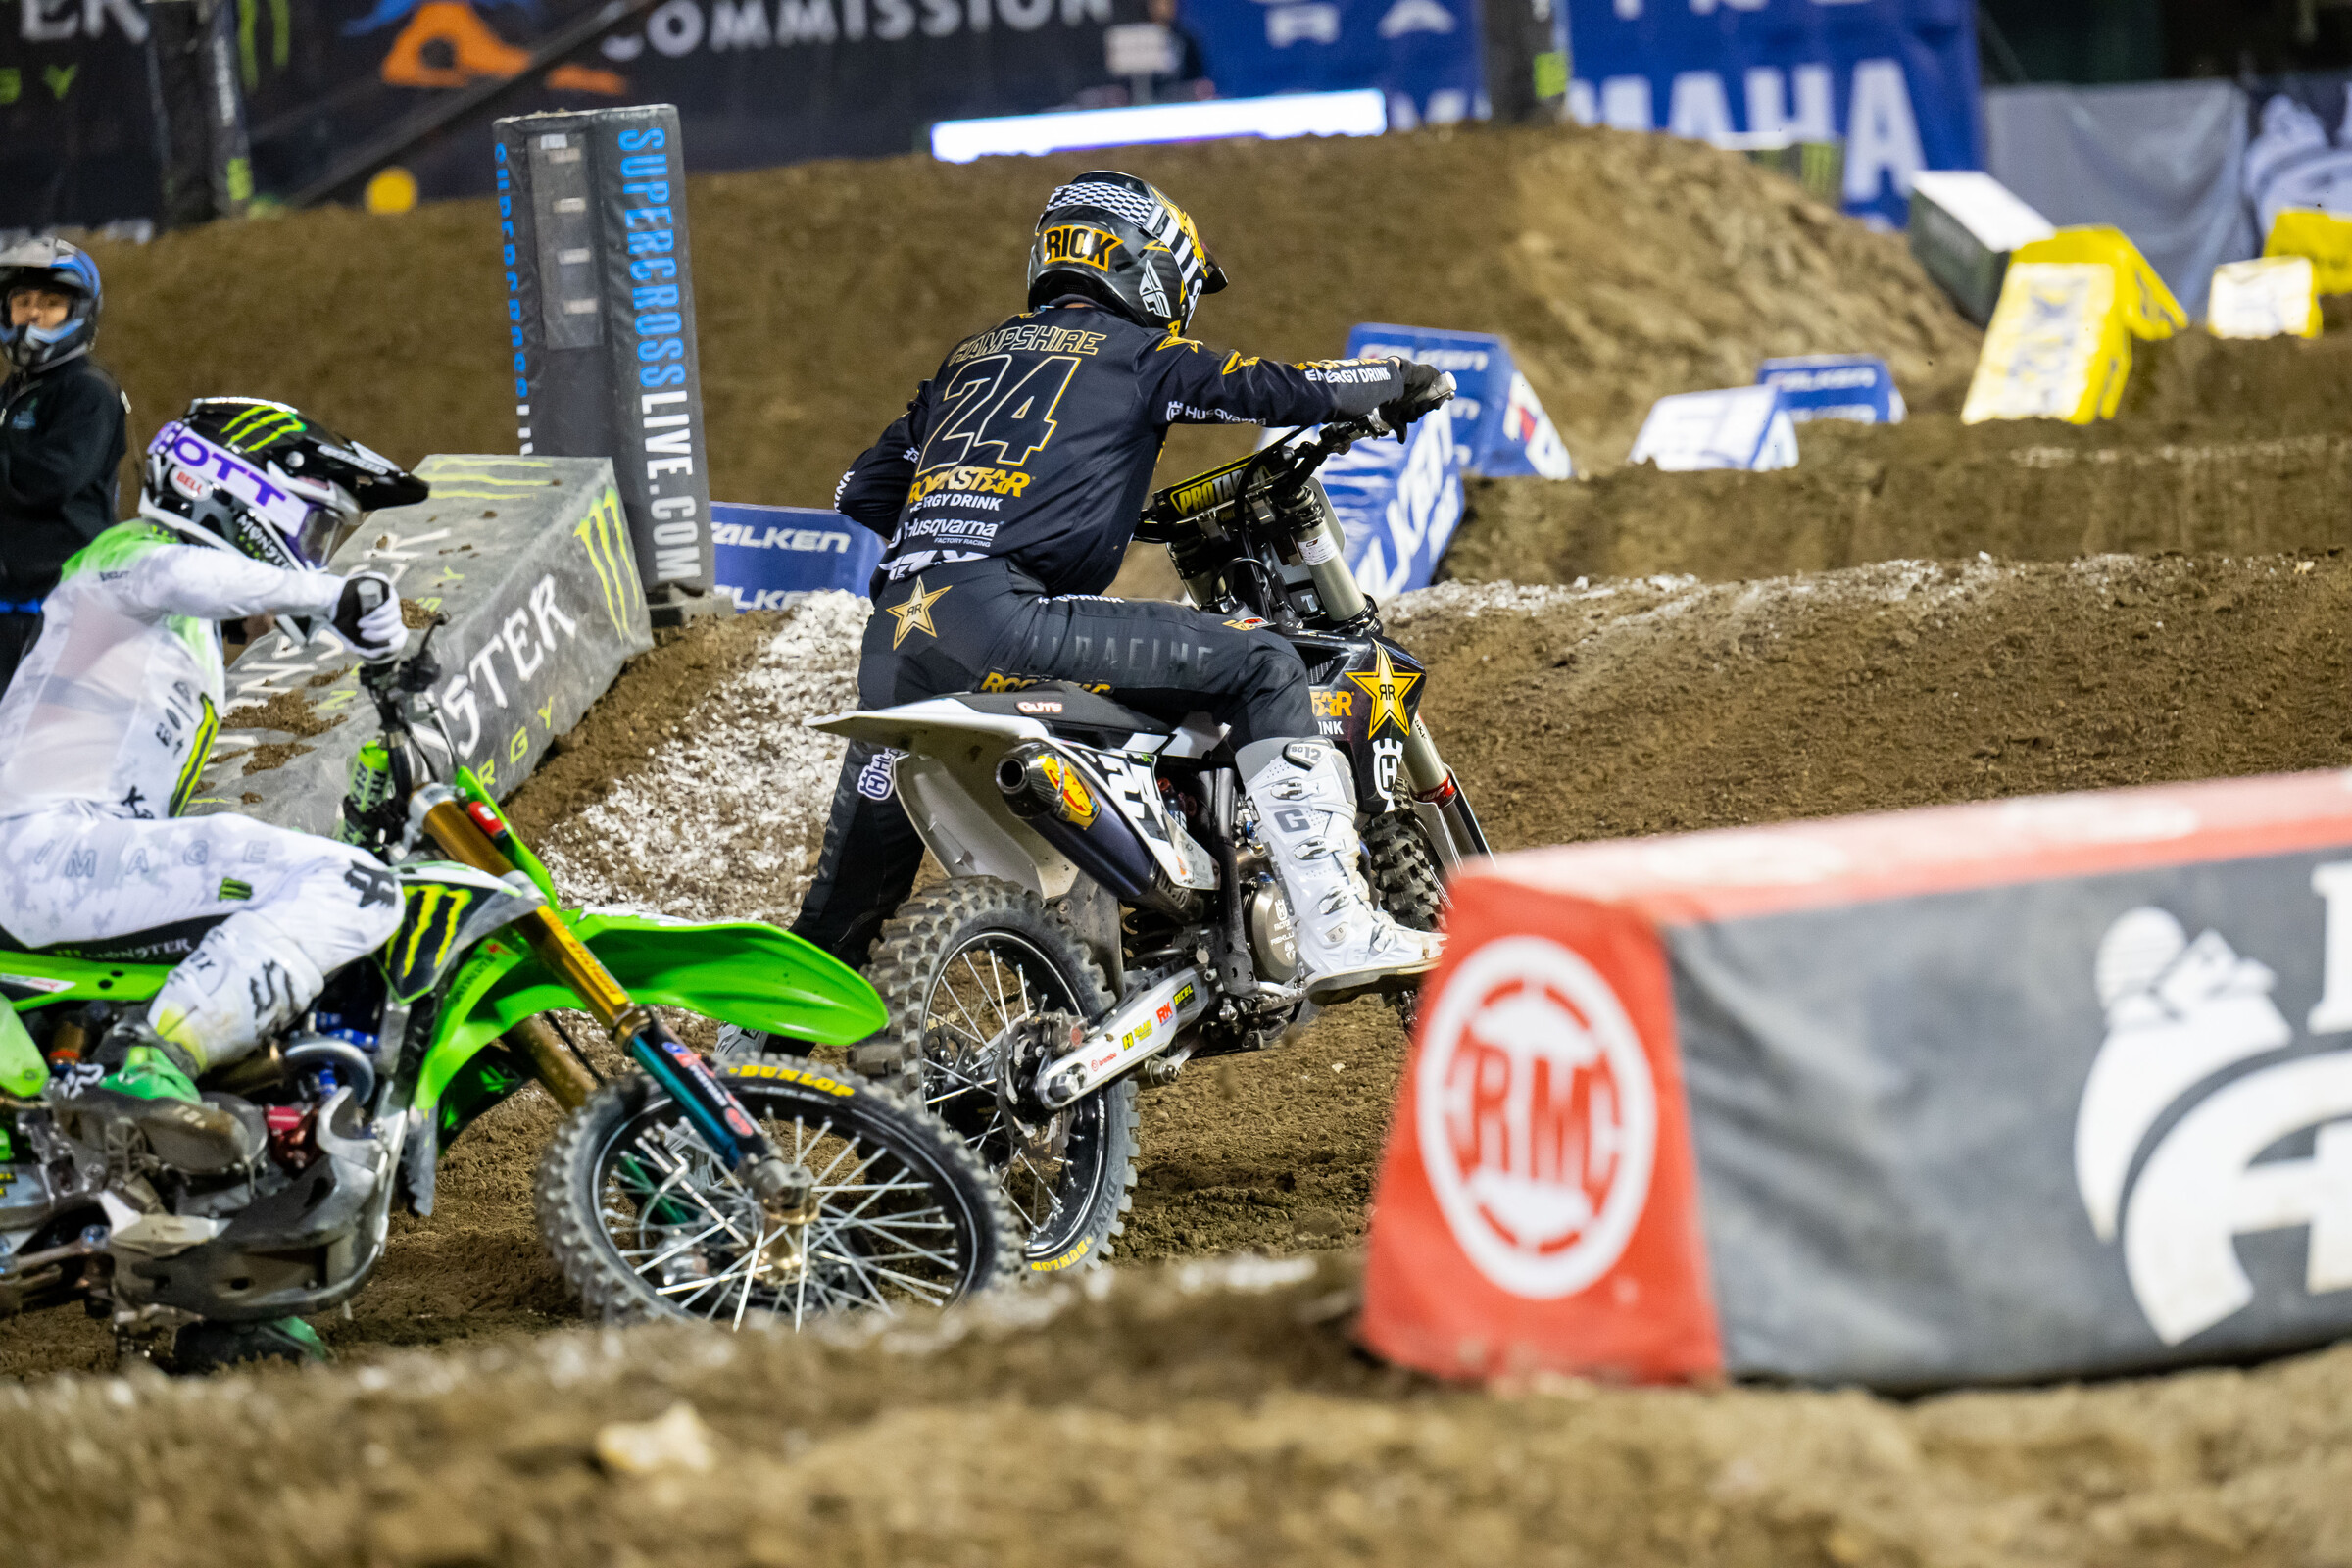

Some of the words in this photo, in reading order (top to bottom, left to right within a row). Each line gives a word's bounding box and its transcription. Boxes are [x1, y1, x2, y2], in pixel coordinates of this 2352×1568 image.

[1046, 227, 1118, 268] RICK
[947, 324, 1107, 368] HAMPSHIRE
[1359, 366, 1392, 384] DRINK
[915, 353, 1082, 477] 24
[1184, 404, 1268, 428] Husqvarna
[175, 470, 204, 497] BELL
[950, 493, 1004, 513] DRINK
[904, 516, 999, 541] Husqvarna
[933, 536, 963, 545] FACTORY
[962, 538, 992, 548] RACING
[1016, 702, 1063, 714] GUTS
[1155, 1002, 1173, 1024] RK
[1098, 1051, 1118, 1067] brembo
[739, 1064, 856, 1097] DUNLOP
[1030, 1244, 1090, 1272] DUNLOP
